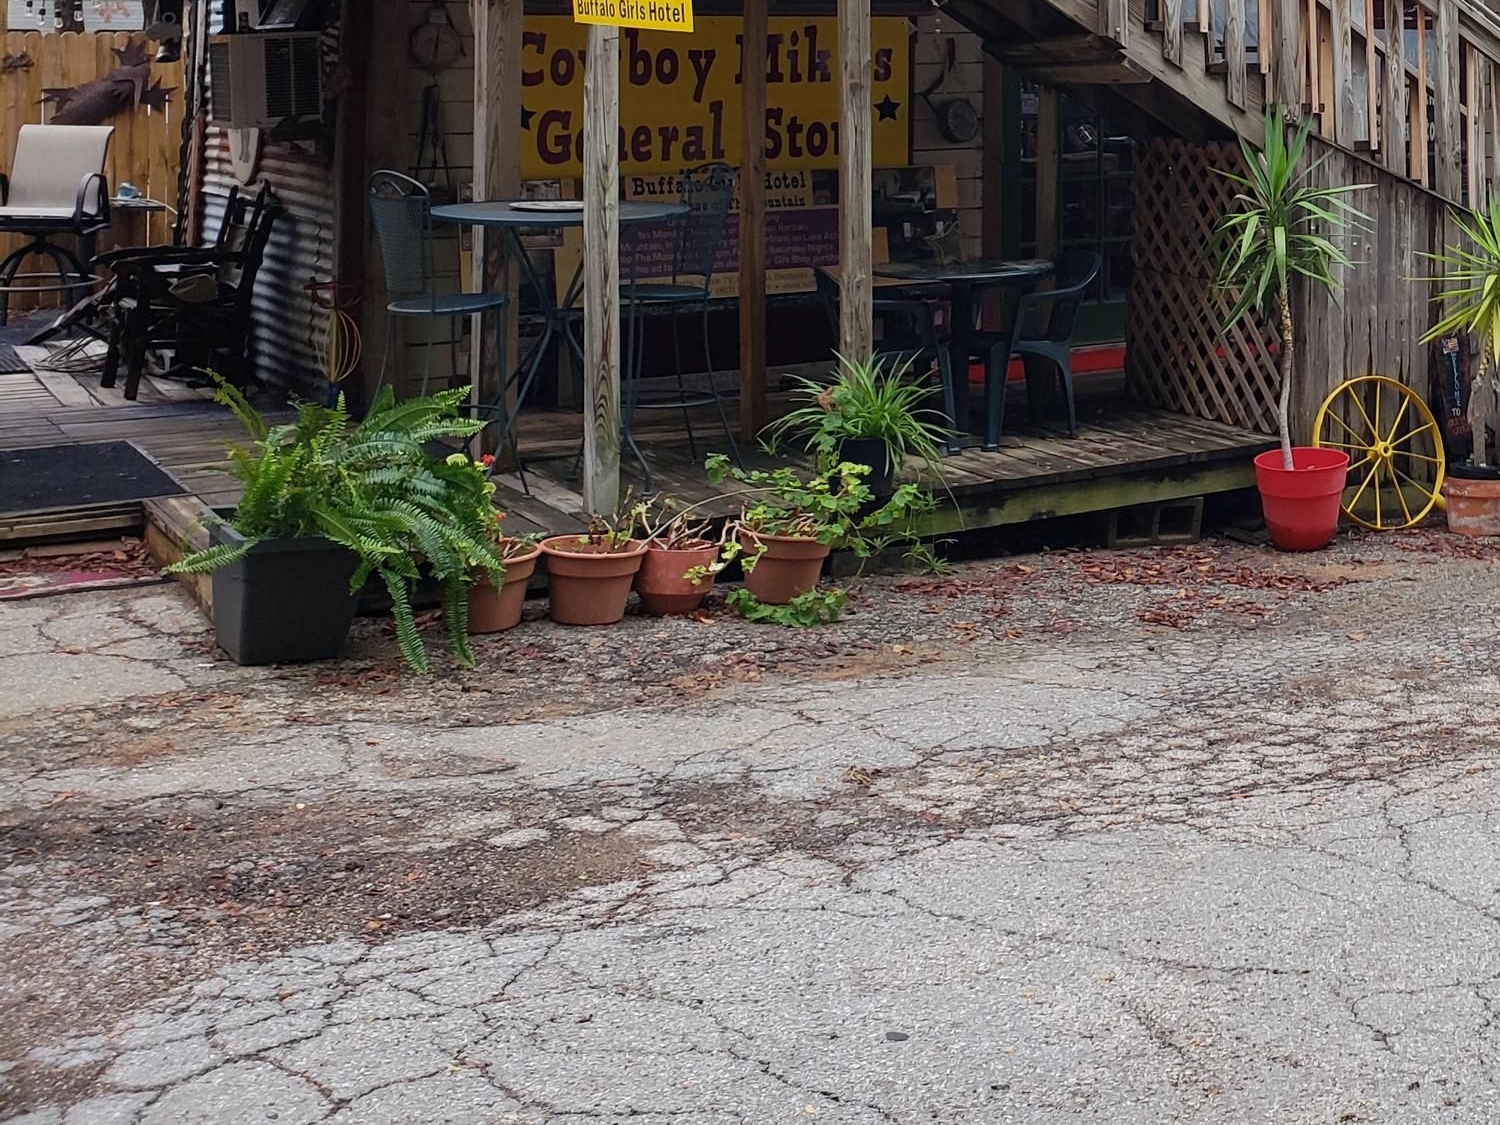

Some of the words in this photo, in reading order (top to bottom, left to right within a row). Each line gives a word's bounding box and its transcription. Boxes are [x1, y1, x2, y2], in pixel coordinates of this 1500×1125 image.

[618, 0, 646, 20] Girls
[648, 1, 686, 23] Hotel
[521, 28, 717, 104] Coboy
[734, 24, 894, 85] Miks
[536, 99, 726, 165] Geral
[764, 106, 840, 159] Sto
[631, 175, 704, 196] Buffao
[766, 195, 806, 208] untain
